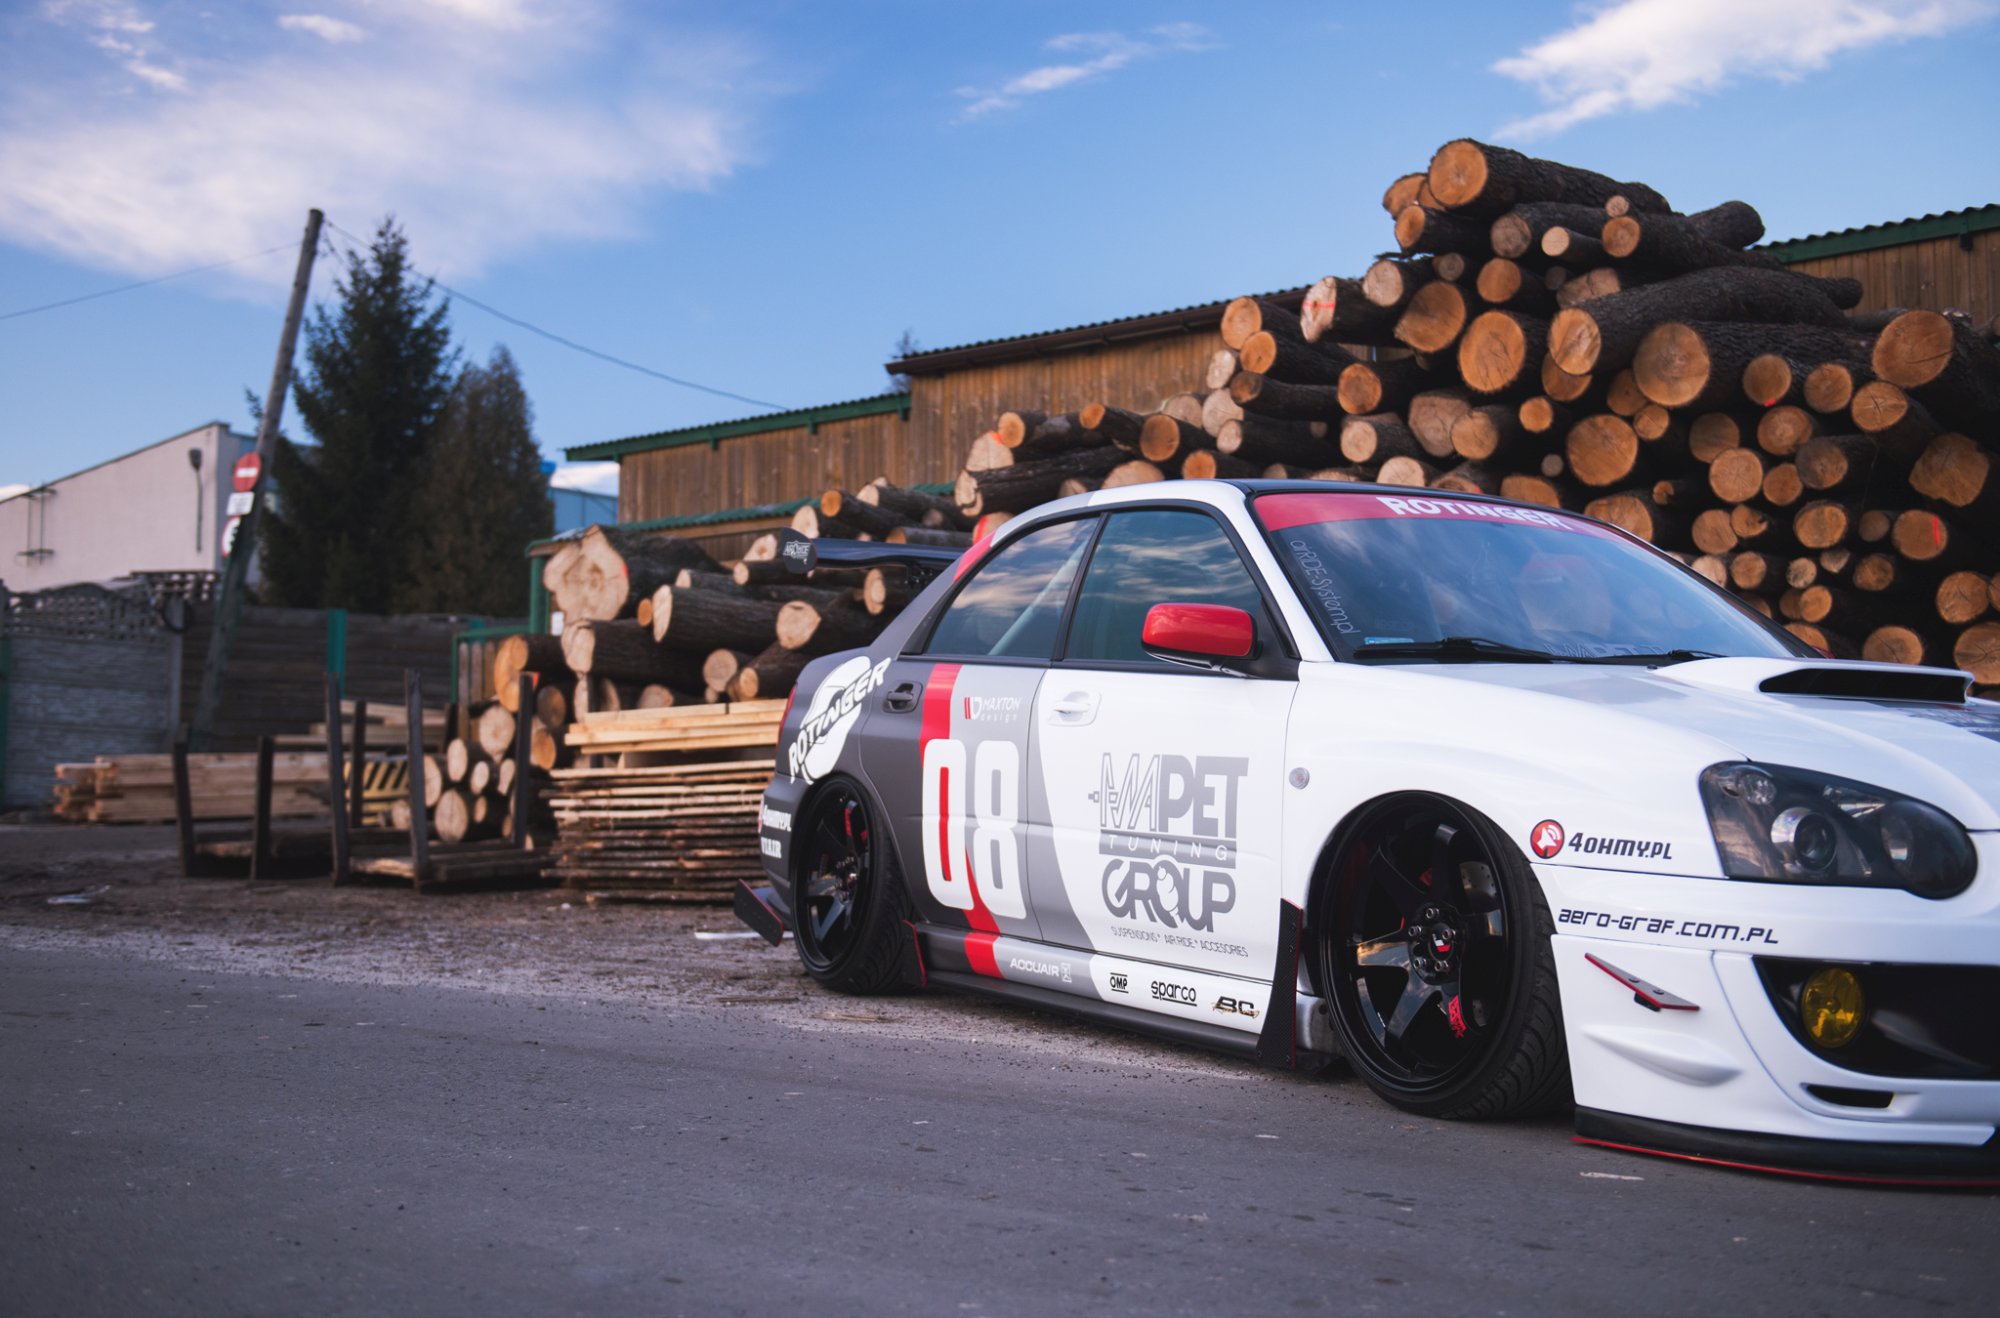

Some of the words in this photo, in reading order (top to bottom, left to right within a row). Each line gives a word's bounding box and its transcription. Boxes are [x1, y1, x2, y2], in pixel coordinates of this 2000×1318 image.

[1376, 496, 1574, 530] ROTINGER
[983, 697, 1020, 711] MAXTON
[788, 656, 892, 785] ROTINGER
[1100, 752, 1249, 839] MAPET
[922, 738, 1027, 919] 08
[1108, 834, 1227, 861] TUNING
[1101, 858, 1236, 933] GROUP
[1010, 958, 1059, 977] ACCUAIR
[1109, 975, 1128, 990] OMP
[1151, 980, 1197, 1002] sparco
[1216, 996, 1254, 1017] BC
